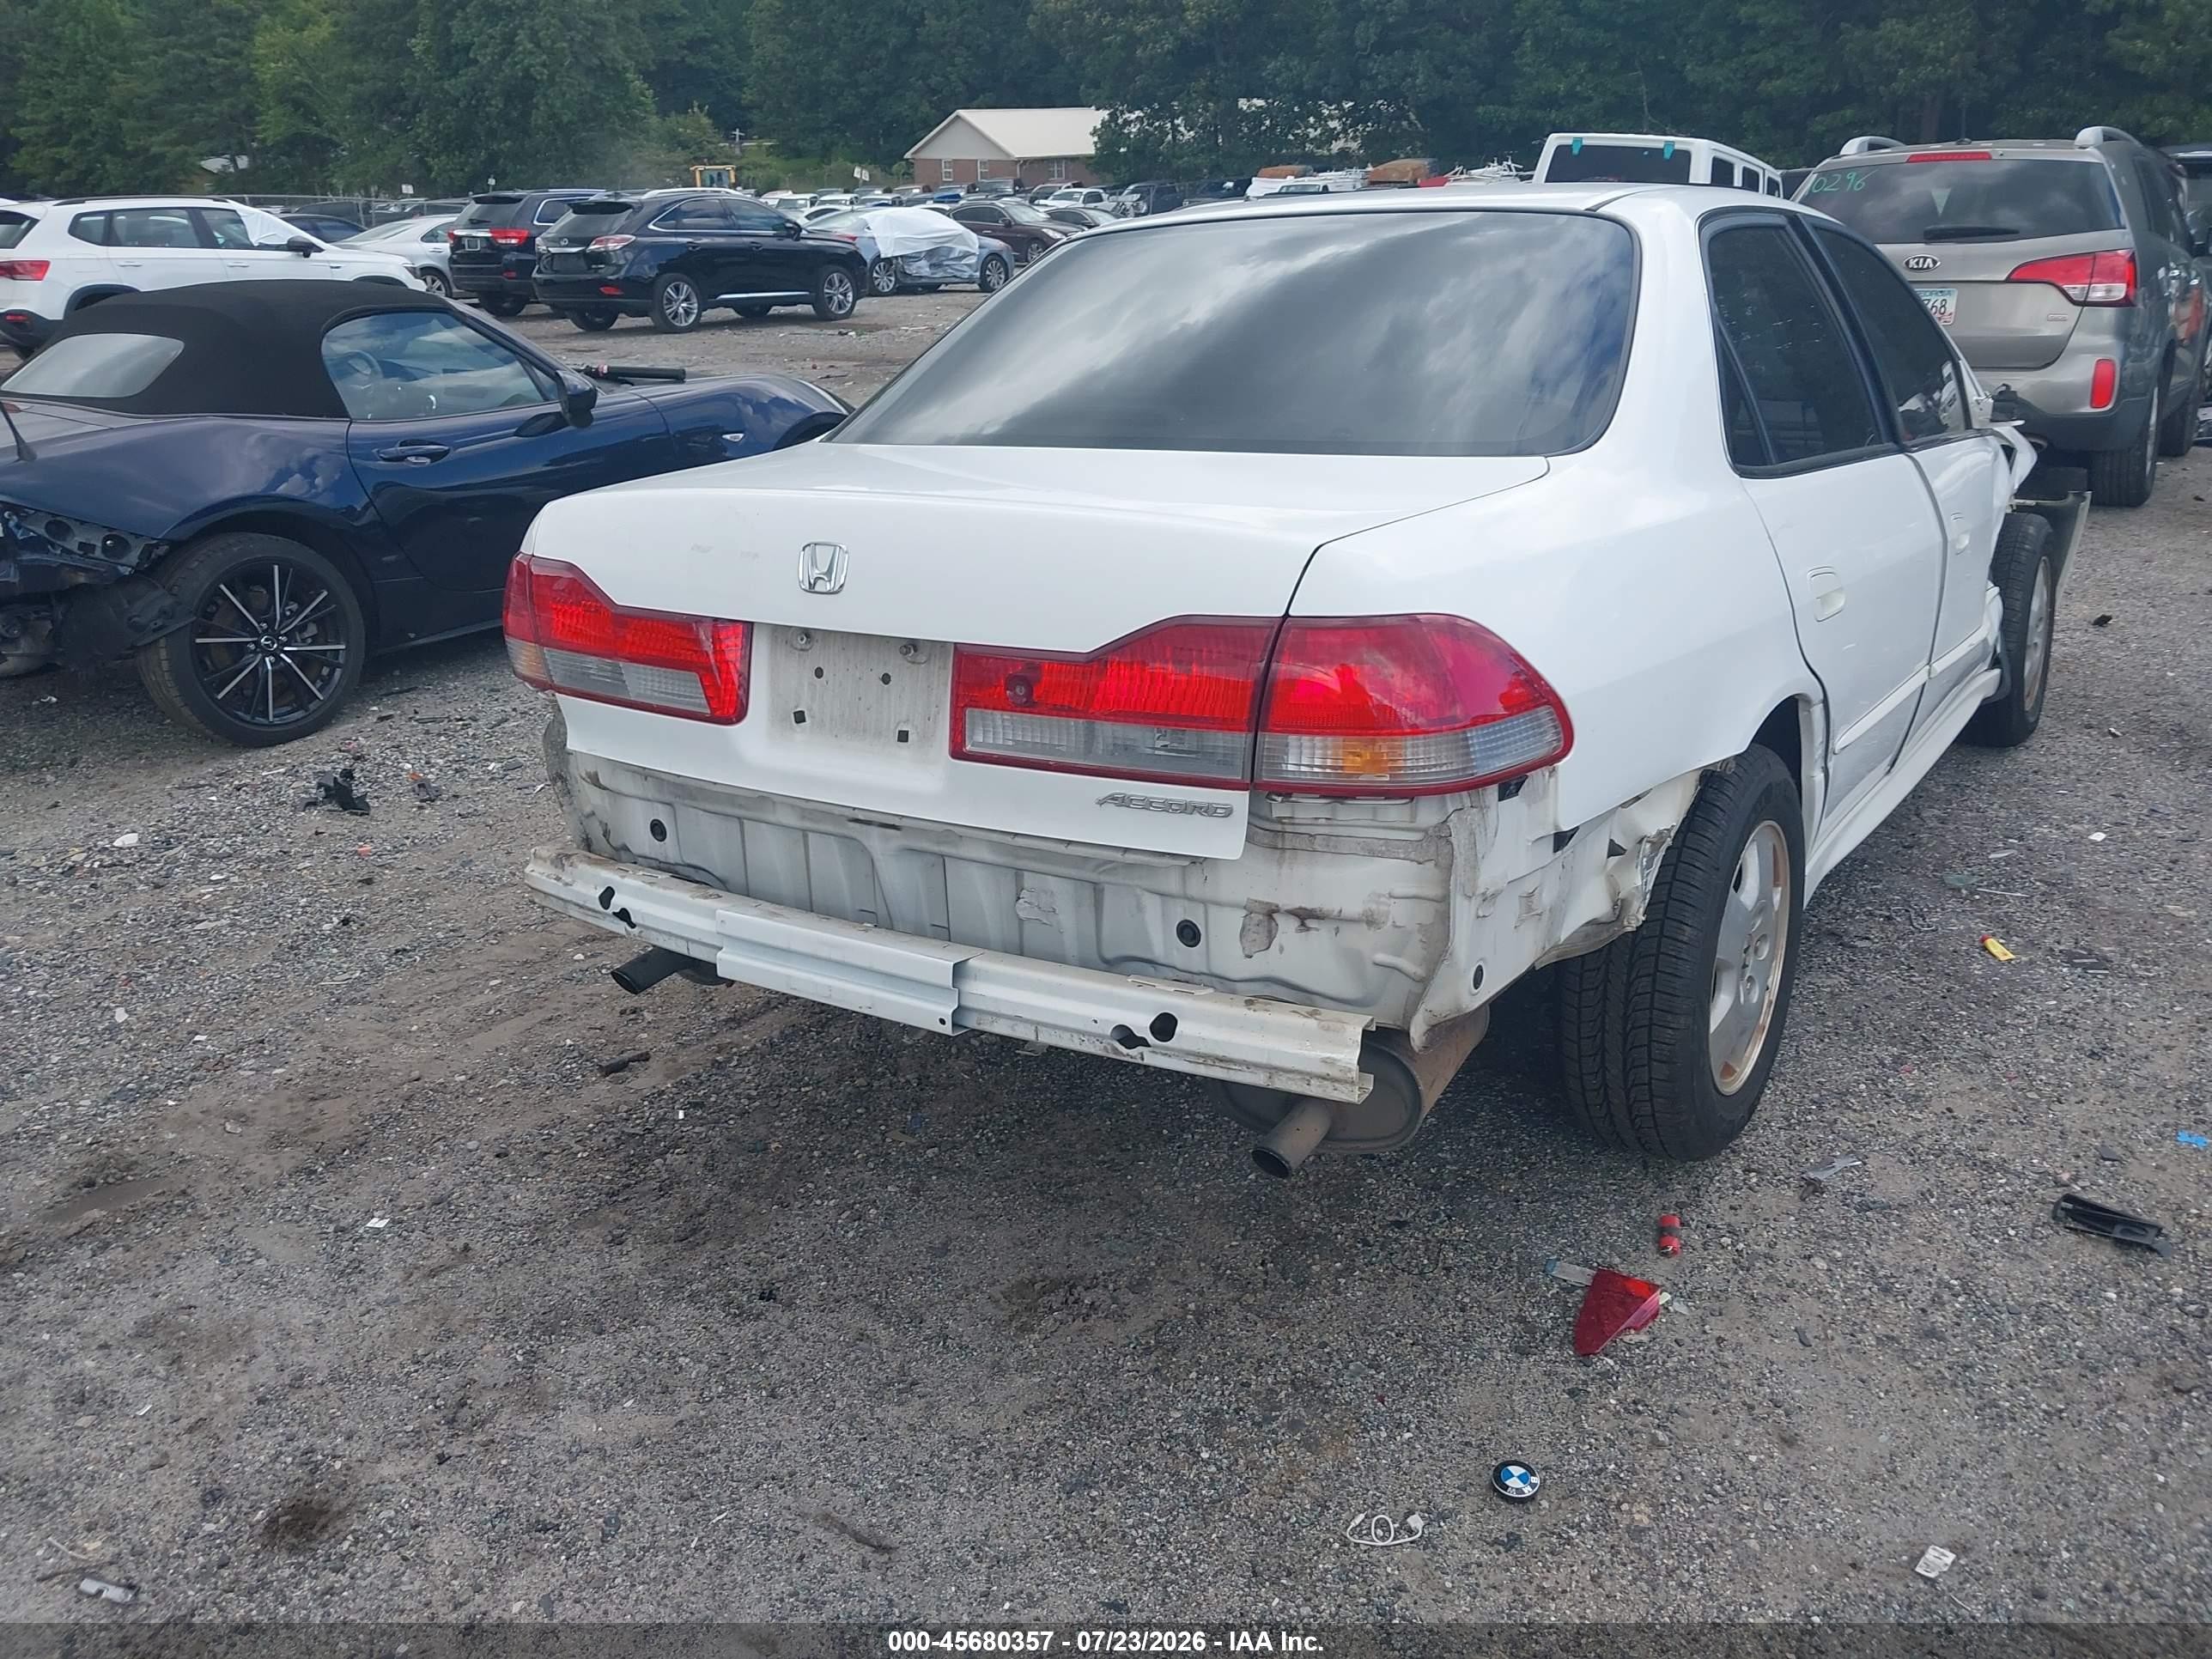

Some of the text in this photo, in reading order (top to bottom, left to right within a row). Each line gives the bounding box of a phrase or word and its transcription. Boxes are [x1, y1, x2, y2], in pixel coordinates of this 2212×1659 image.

[1908, 258, 1934, 269] KIA
[1095, 792, 1234, 818] ACCORD
[1507, 1476, 1538, 1495] BMW
